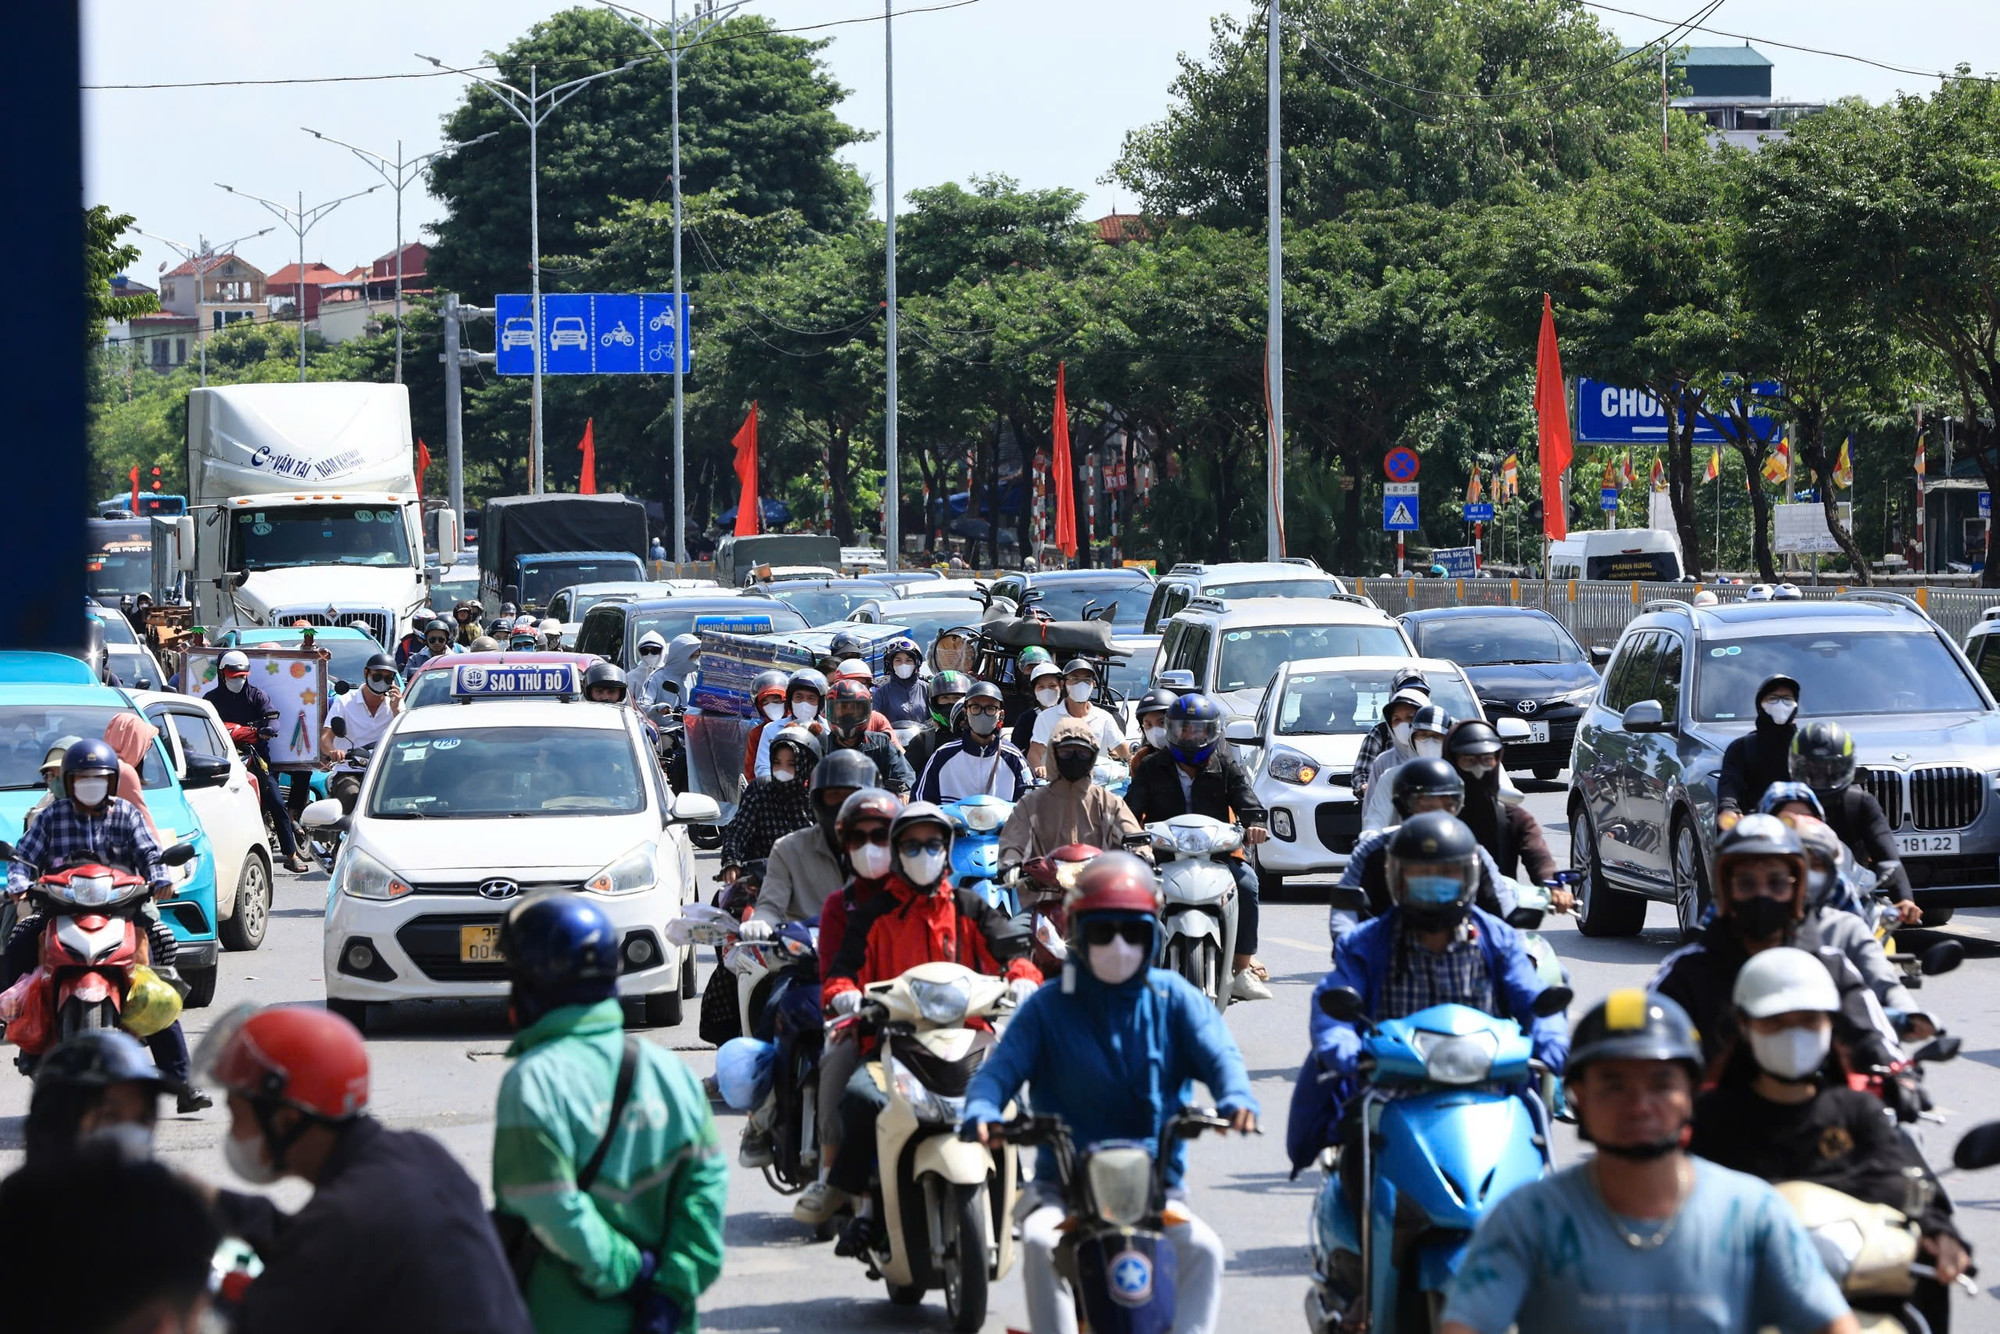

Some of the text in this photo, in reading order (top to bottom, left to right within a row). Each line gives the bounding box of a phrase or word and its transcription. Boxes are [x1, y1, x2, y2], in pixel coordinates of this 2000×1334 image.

[753, 623, 771, 633] TAXI
[489, 668, 563, 692] SAO THỦ ĐÔ
